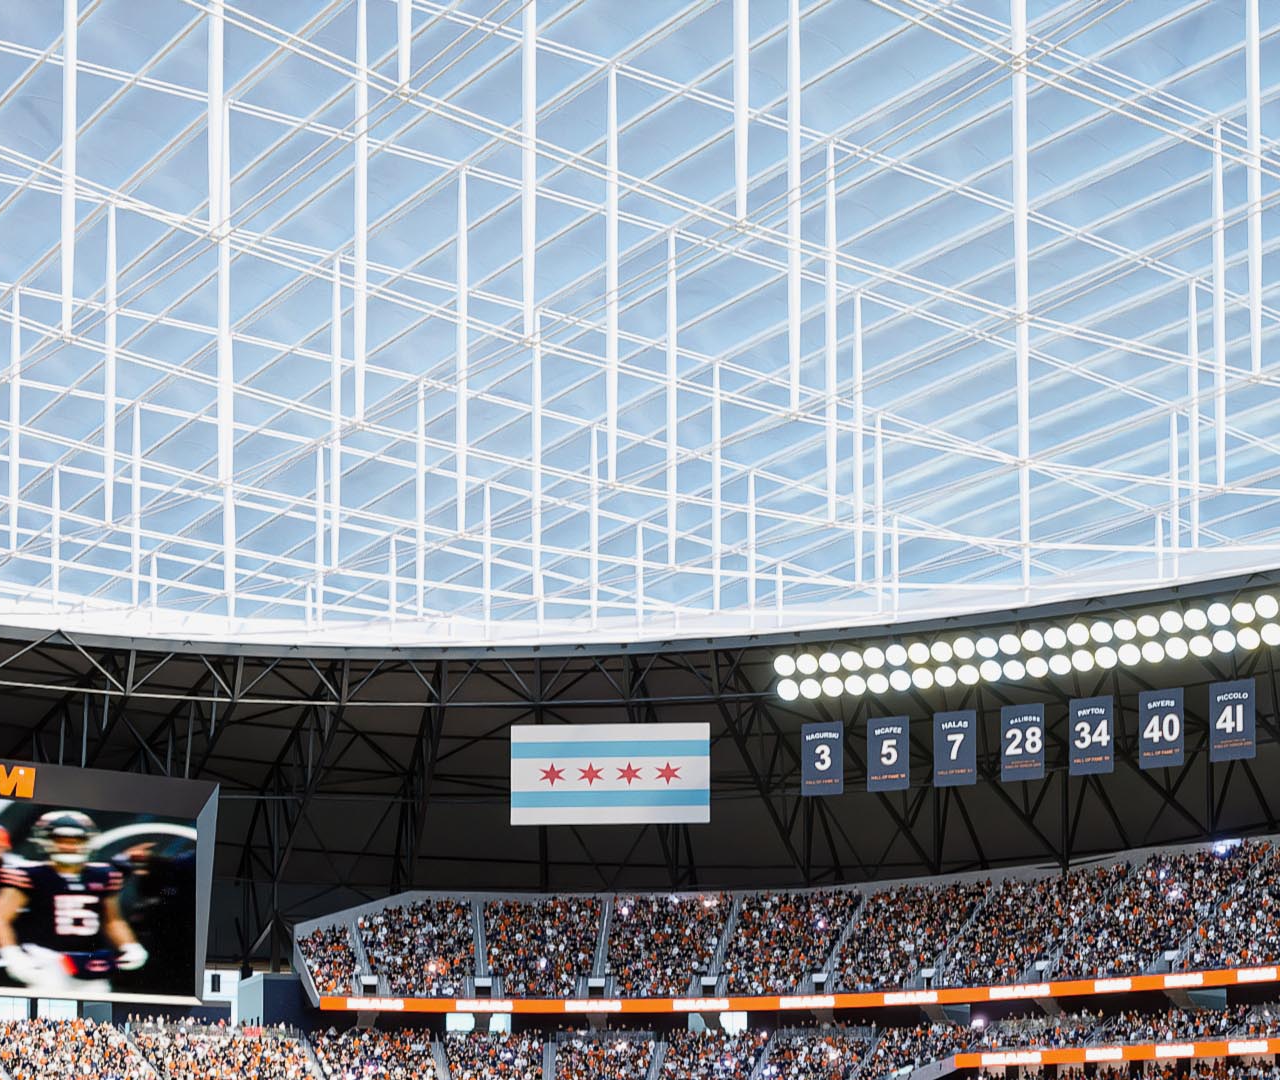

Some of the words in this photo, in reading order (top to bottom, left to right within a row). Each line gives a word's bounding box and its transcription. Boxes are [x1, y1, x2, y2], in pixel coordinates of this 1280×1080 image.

[1147, 700, 1175, 710] SAYERS
[1216, 692, 1249, 703] PICCOLO
[941, 720, 969, 730] HALAS
[1077, 708, 1106, 717] PAYTON
[1216, 704, 1244, 734] 41
[805, 732, 840, 741] NAGURSKI
[874, 726, 902, 736] MCAFEE
[1005, 726, 1043, 756] 28
[1074, 719, 1111, 750] 34
[1143, 713, 1180, 743] 40
[814, 744, 832, 771] 3
[880, 739, 898, 766] 5
[946, 733, 964, 760] 7
